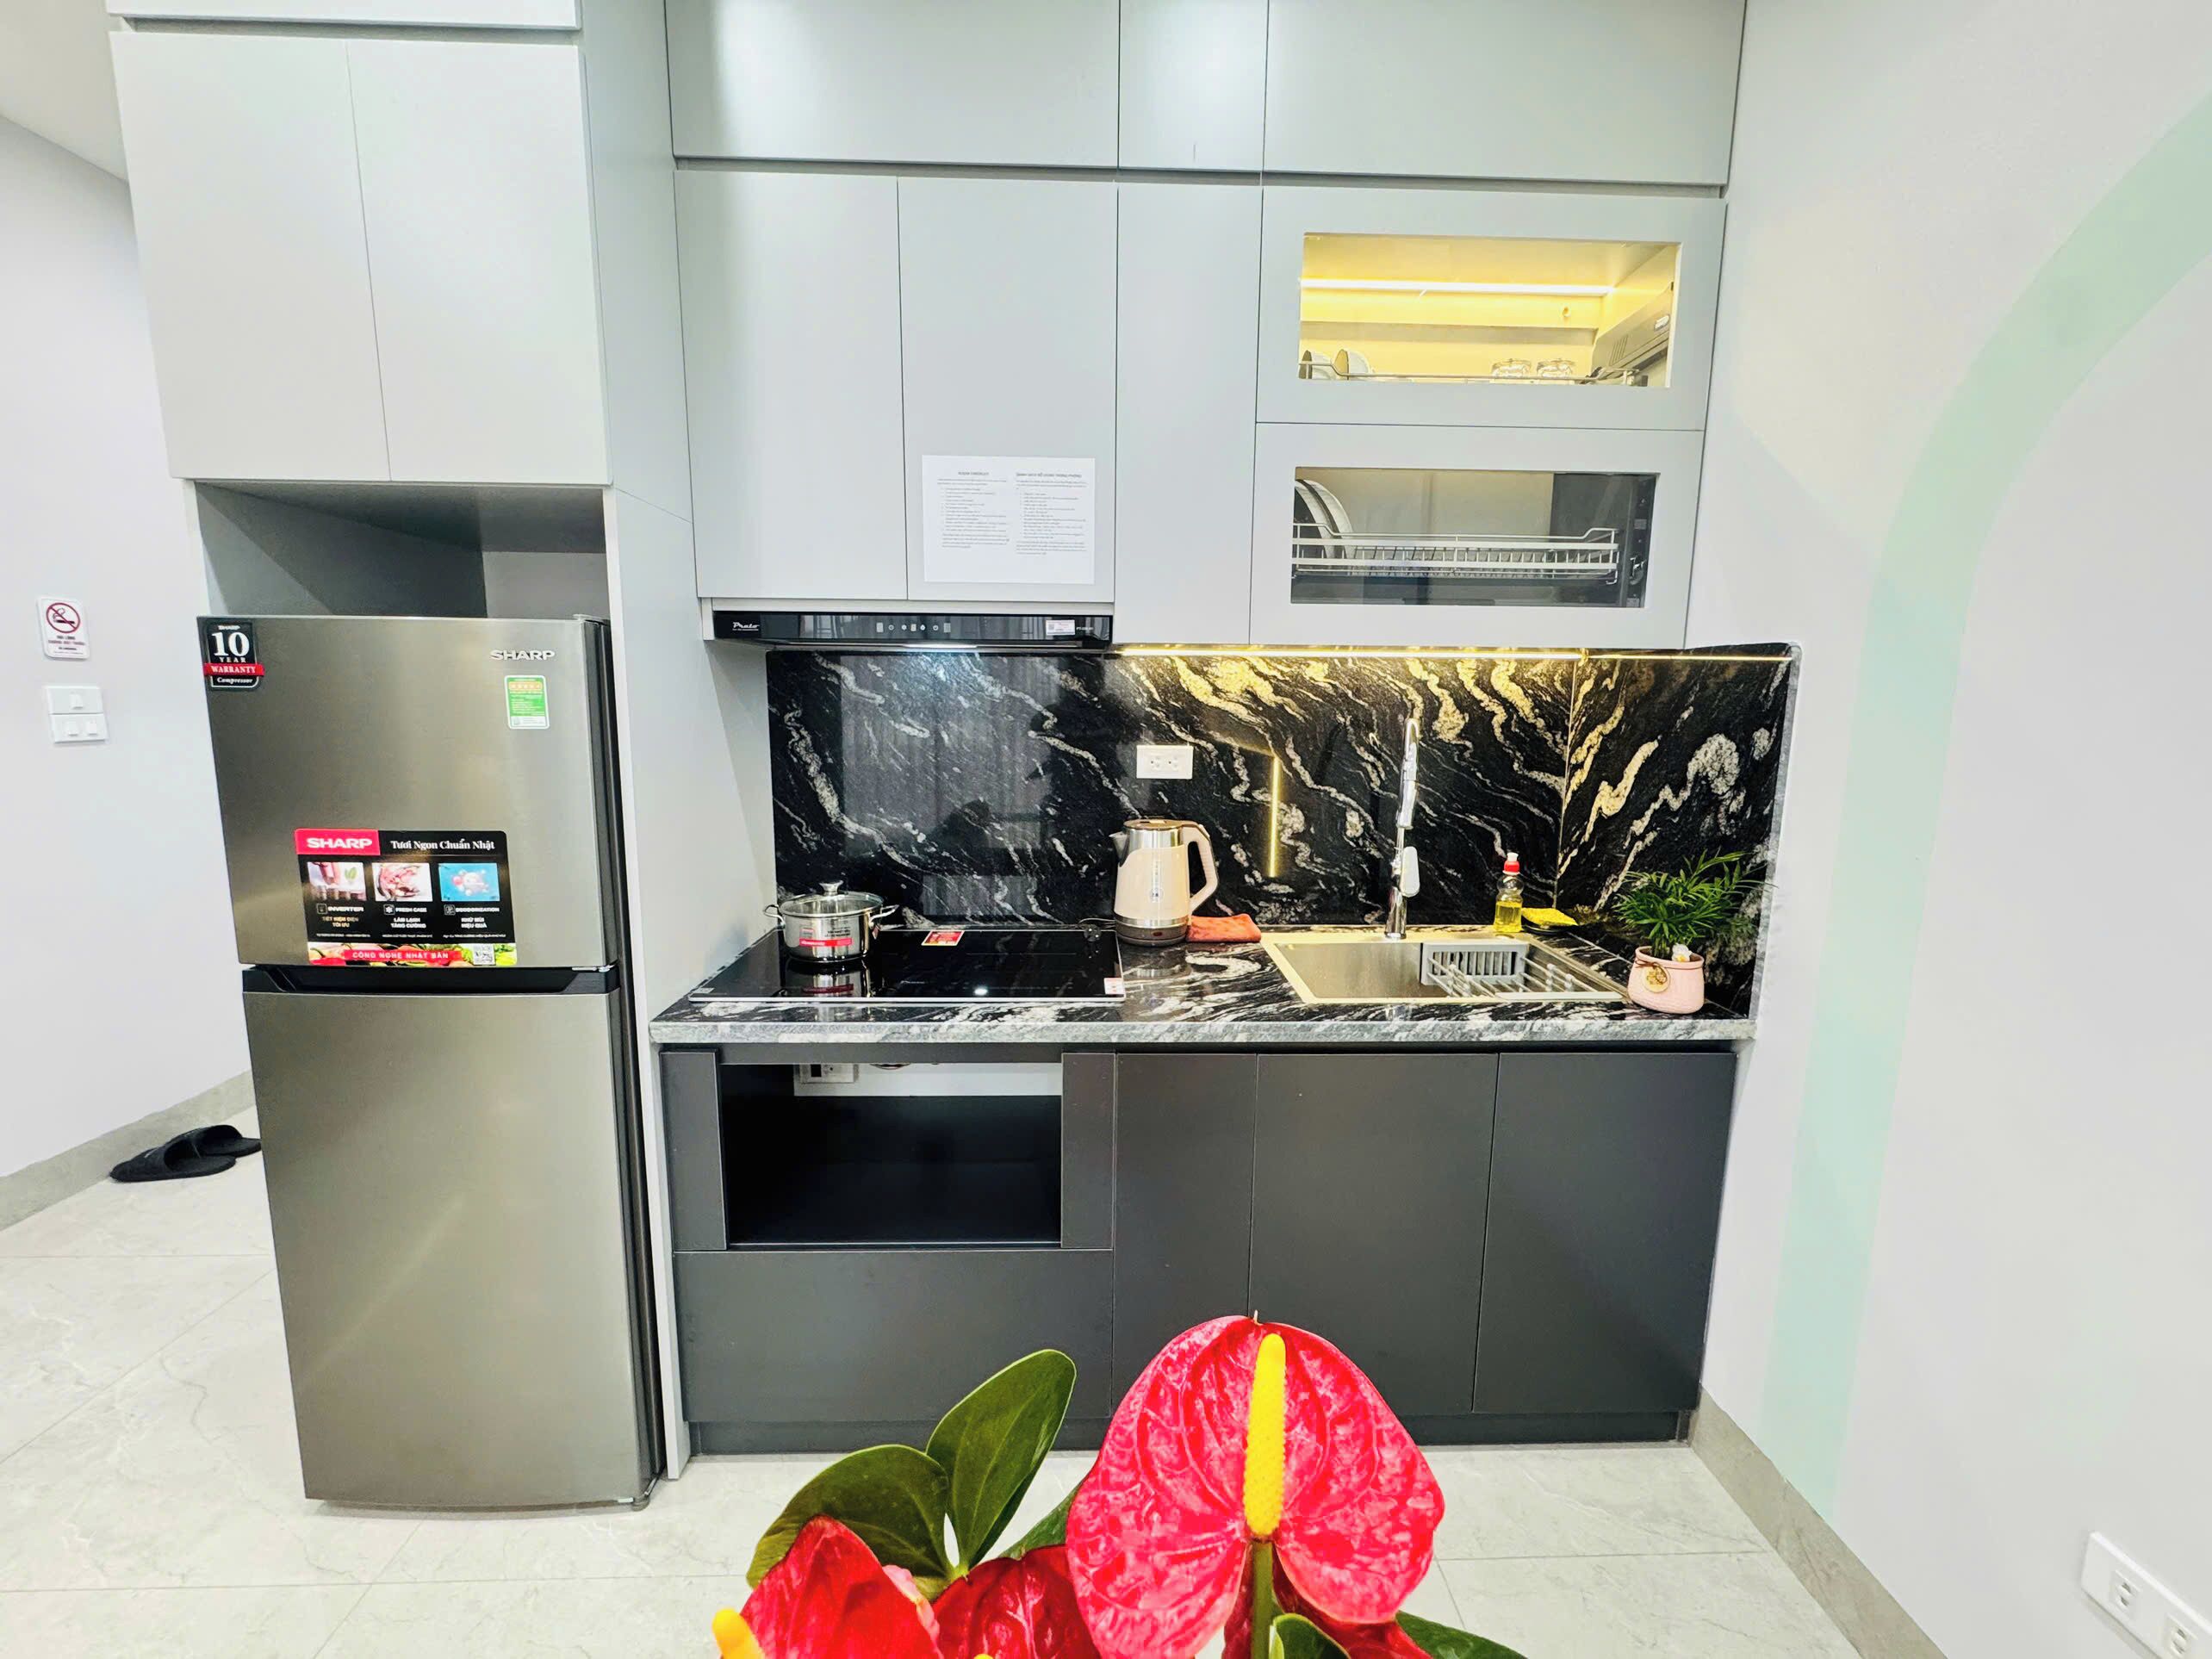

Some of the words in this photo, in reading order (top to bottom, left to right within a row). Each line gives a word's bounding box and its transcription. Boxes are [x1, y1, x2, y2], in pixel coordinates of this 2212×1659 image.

[211, 631, 251, 657] 10
[489, 649, 556, 661] SHARP
[210, 665, 257, 674] WARRANTY
[306, 837, 373, 848] SHARP
[413, 840, 438, 850] Ngon
[472, 840, 495, 851] Nhật
